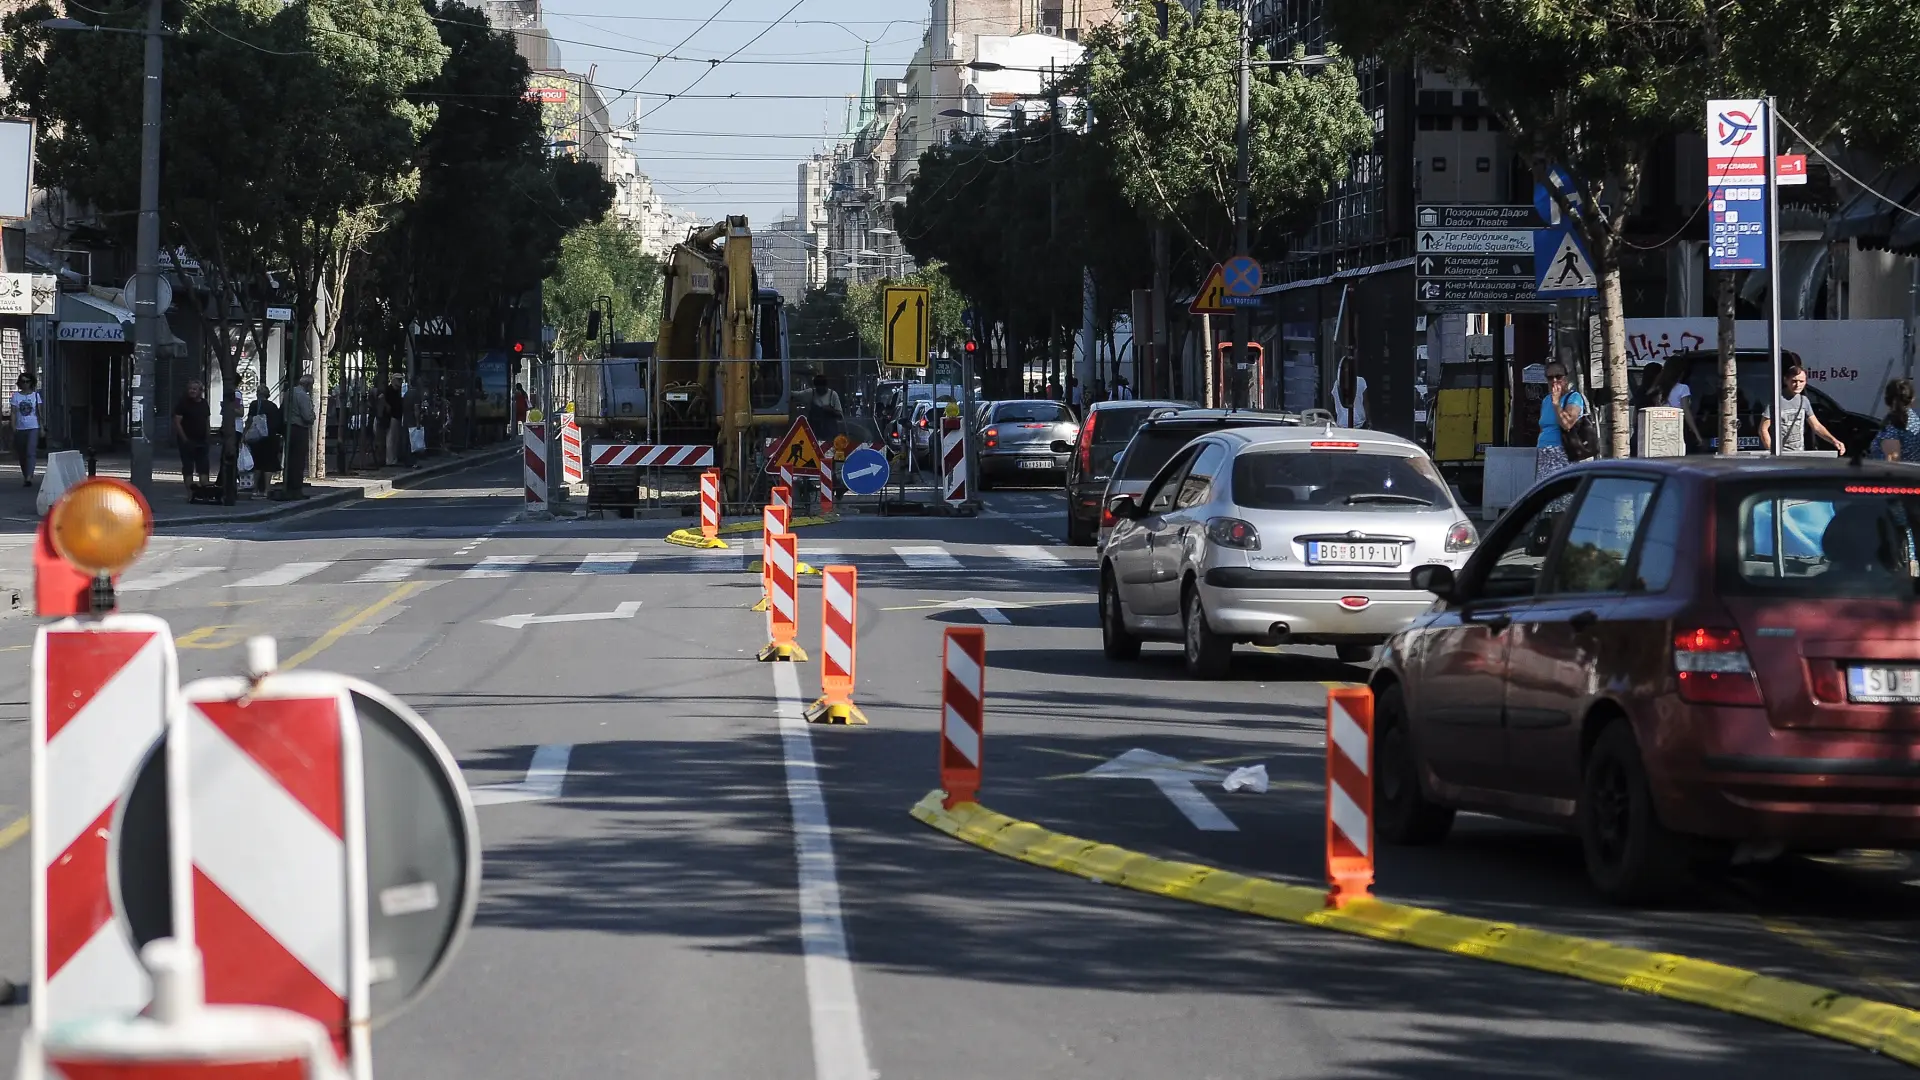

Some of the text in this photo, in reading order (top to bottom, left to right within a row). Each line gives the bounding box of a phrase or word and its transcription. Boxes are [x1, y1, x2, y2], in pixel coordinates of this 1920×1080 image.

[1793, 159, 1801, 171] 1
[1500, 208, 1529, 218] Дадов
[1444, 218, 1508, 226] Dadov Theatre
[1444, 233, 1459, 243] Трг
[1444, 242, 1484, 251] Republic
[1484, 242, 1515, 252] Square
[1444, 257, 1499, 266] Калемегдан
[1444, 266, 1499, 276] Kalemegdan
[1444, 291, 1467, 299] Knez
[1468, 291, 1508, 299] Mihailova
[1515, 291, 1536, 300] pede
[60, 326, 123, 339] OPTIČAR
[1807, 366, 1858, 382] ing b&p
[1321, 544, 1338, 559] BG
[1870, 672, 1897, 692] SD
